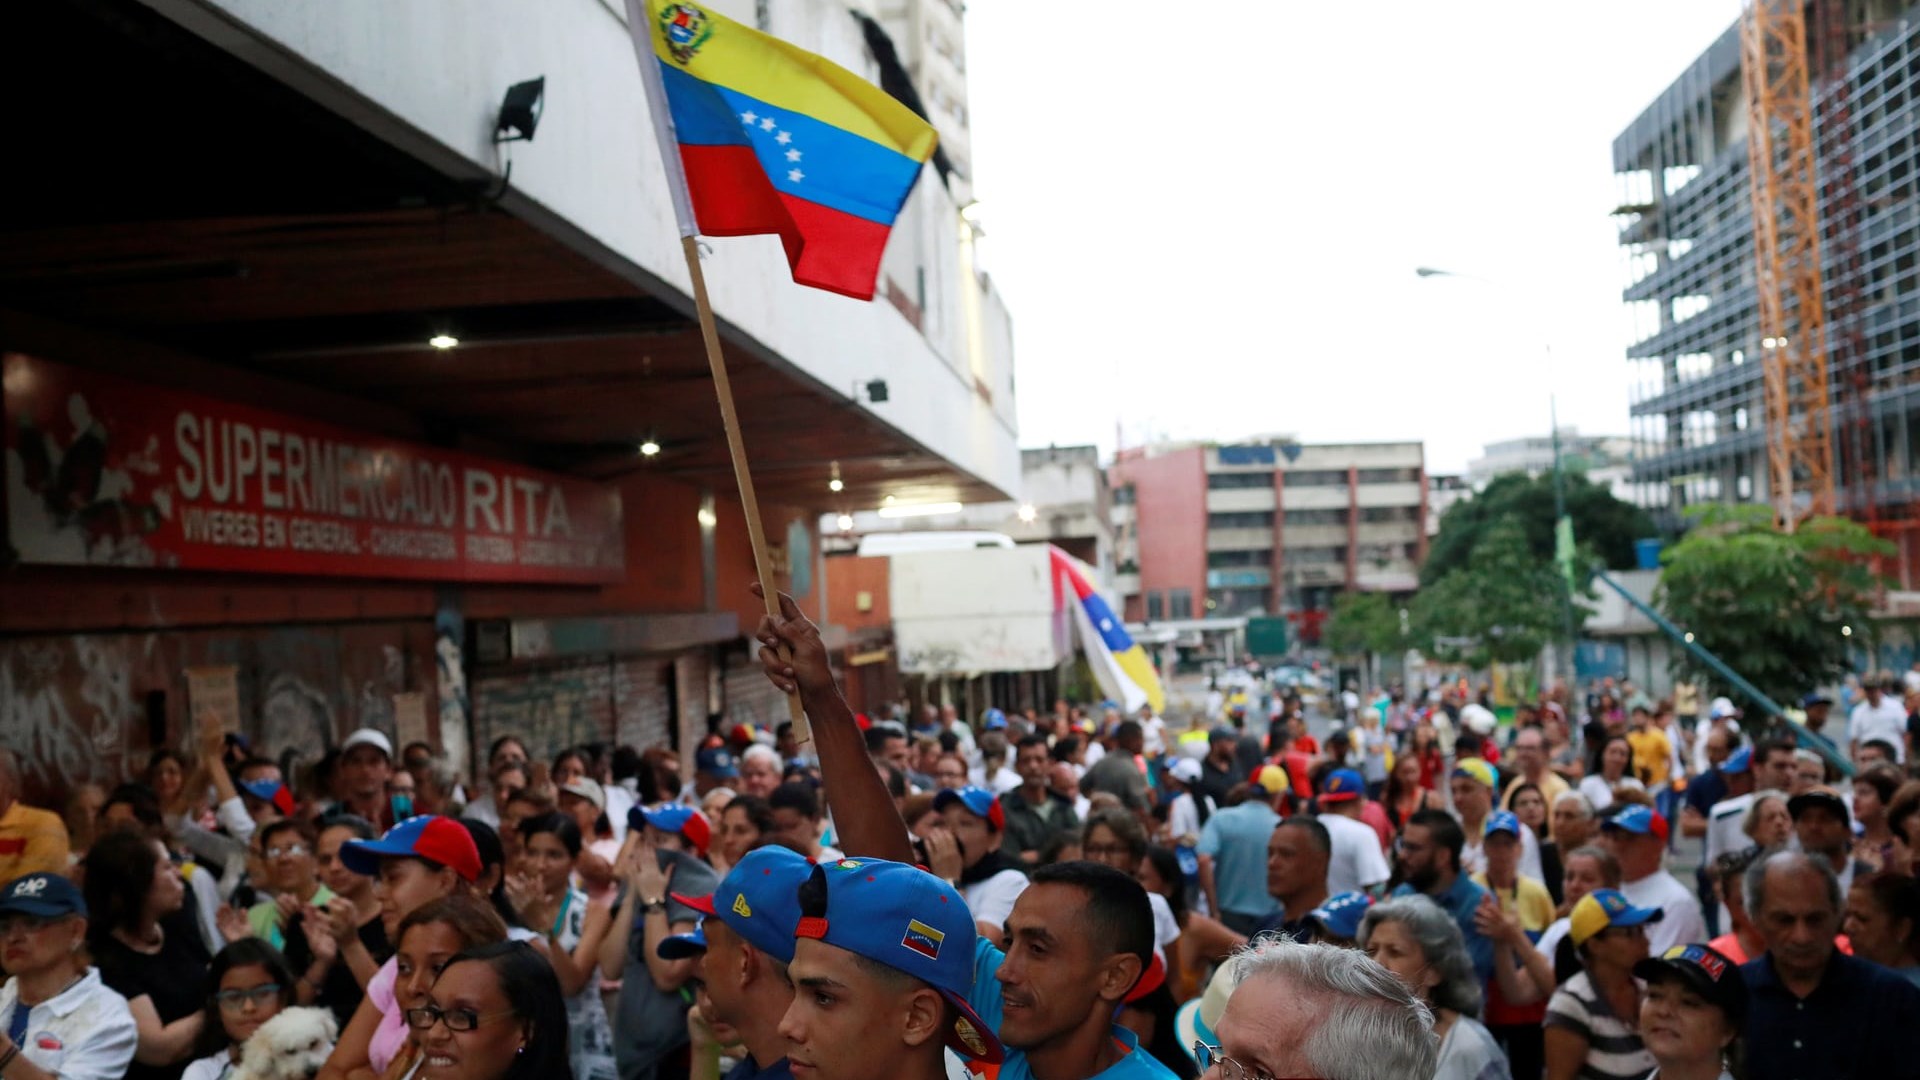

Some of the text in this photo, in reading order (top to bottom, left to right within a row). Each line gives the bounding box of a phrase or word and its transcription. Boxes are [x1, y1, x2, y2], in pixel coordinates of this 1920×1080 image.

[175, 411, 573, 537] SUPERMERCADO RITA
[180, 507, 258, 547] VIVERES
[263, 513, 287, 549] EN
[289, 516, 361, 554] GENERAL
